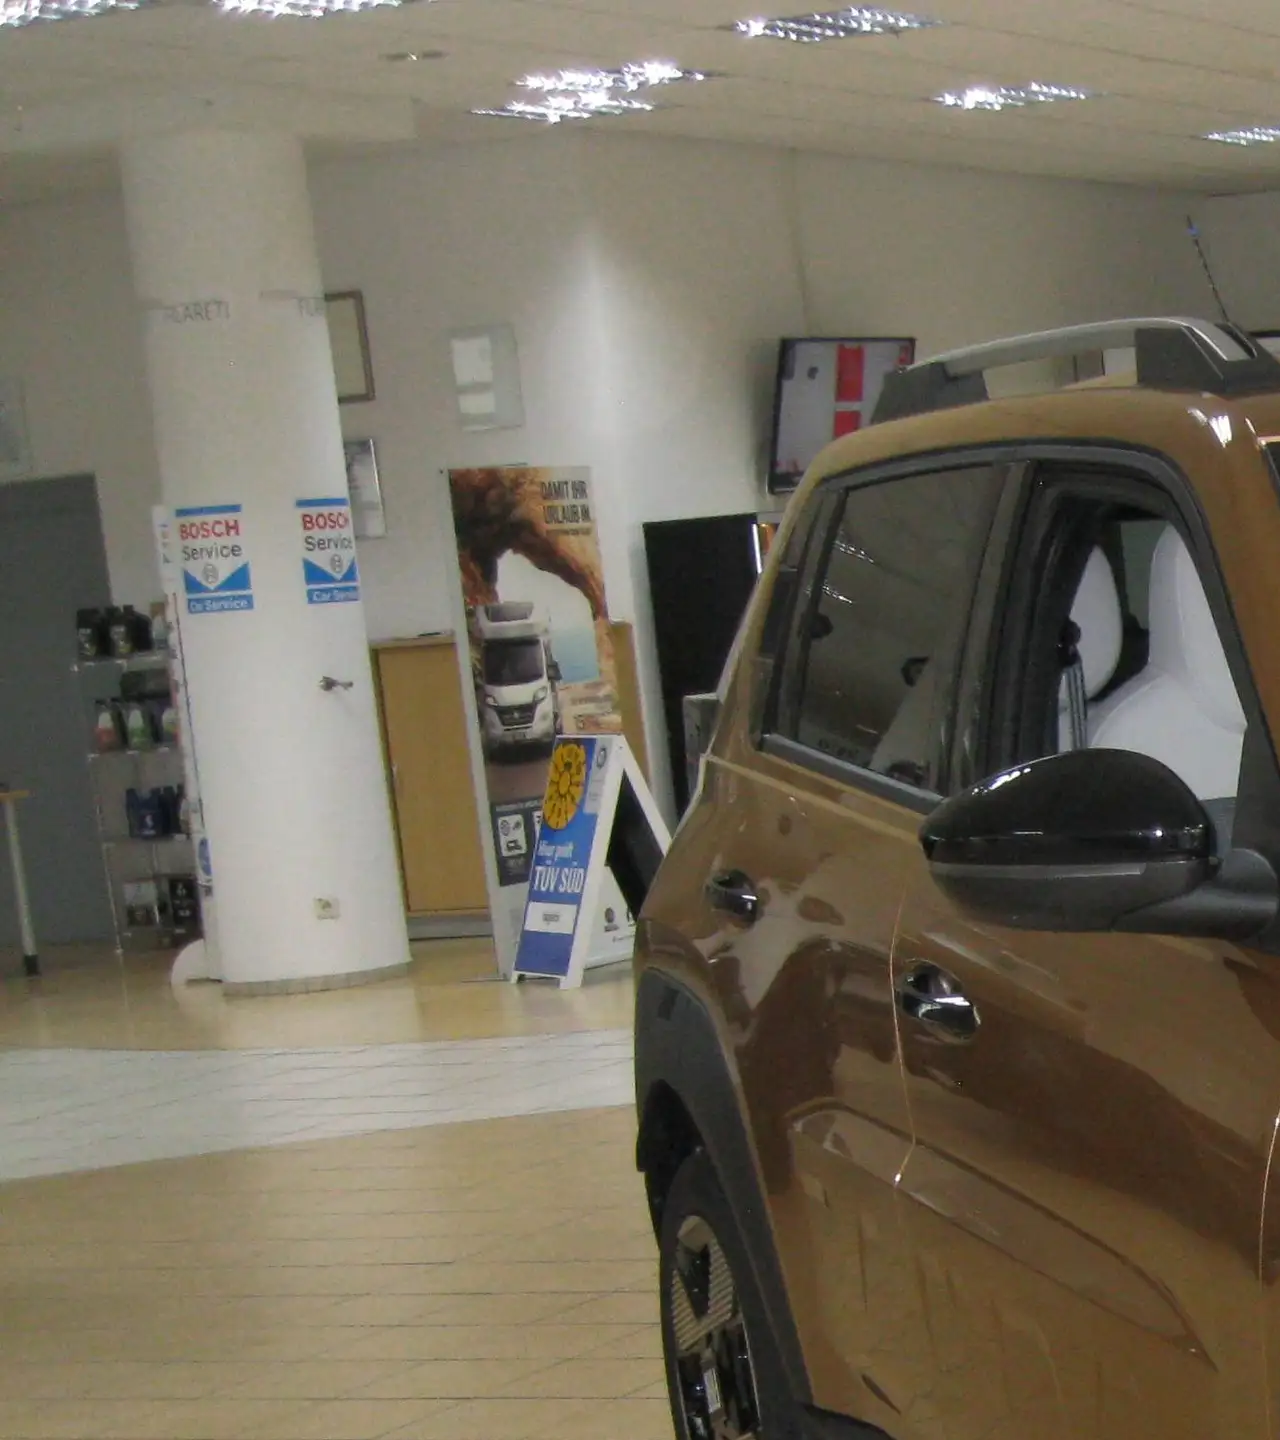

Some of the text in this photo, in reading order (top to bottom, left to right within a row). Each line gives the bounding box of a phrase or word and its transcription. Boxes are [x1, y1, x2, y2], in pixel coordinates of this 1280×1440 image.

[179, 519, 240, 541] BOSCH
[302, 512, 349, 531] BOSC
[182, 542, 243, 562] Service
[304, 534, 353, 552] Servic
